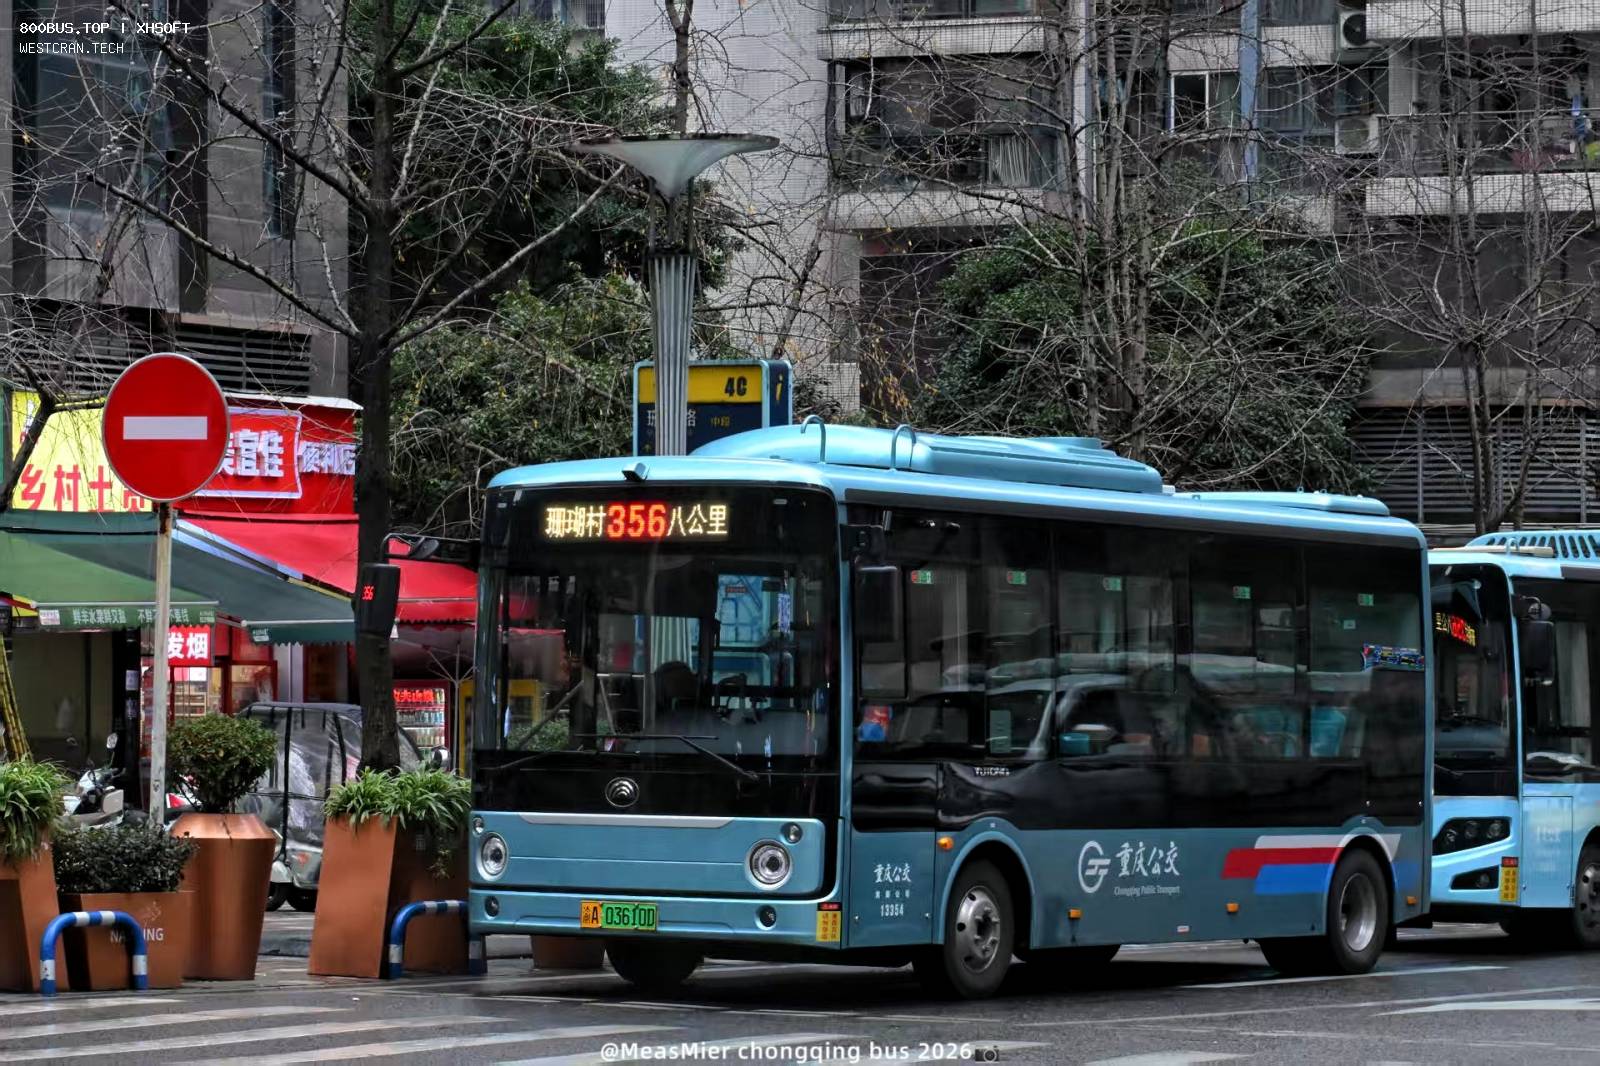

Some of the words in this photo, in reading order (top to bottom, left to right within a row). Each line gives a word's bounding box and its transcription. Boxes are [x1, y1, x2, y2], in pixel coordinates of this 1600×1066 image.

[545, 503, 728, 538] 珊瑚村356八公里
[873, 863, 911, 883] 重庆公交
[1115, 841, 1180, 877] 重庆公交
